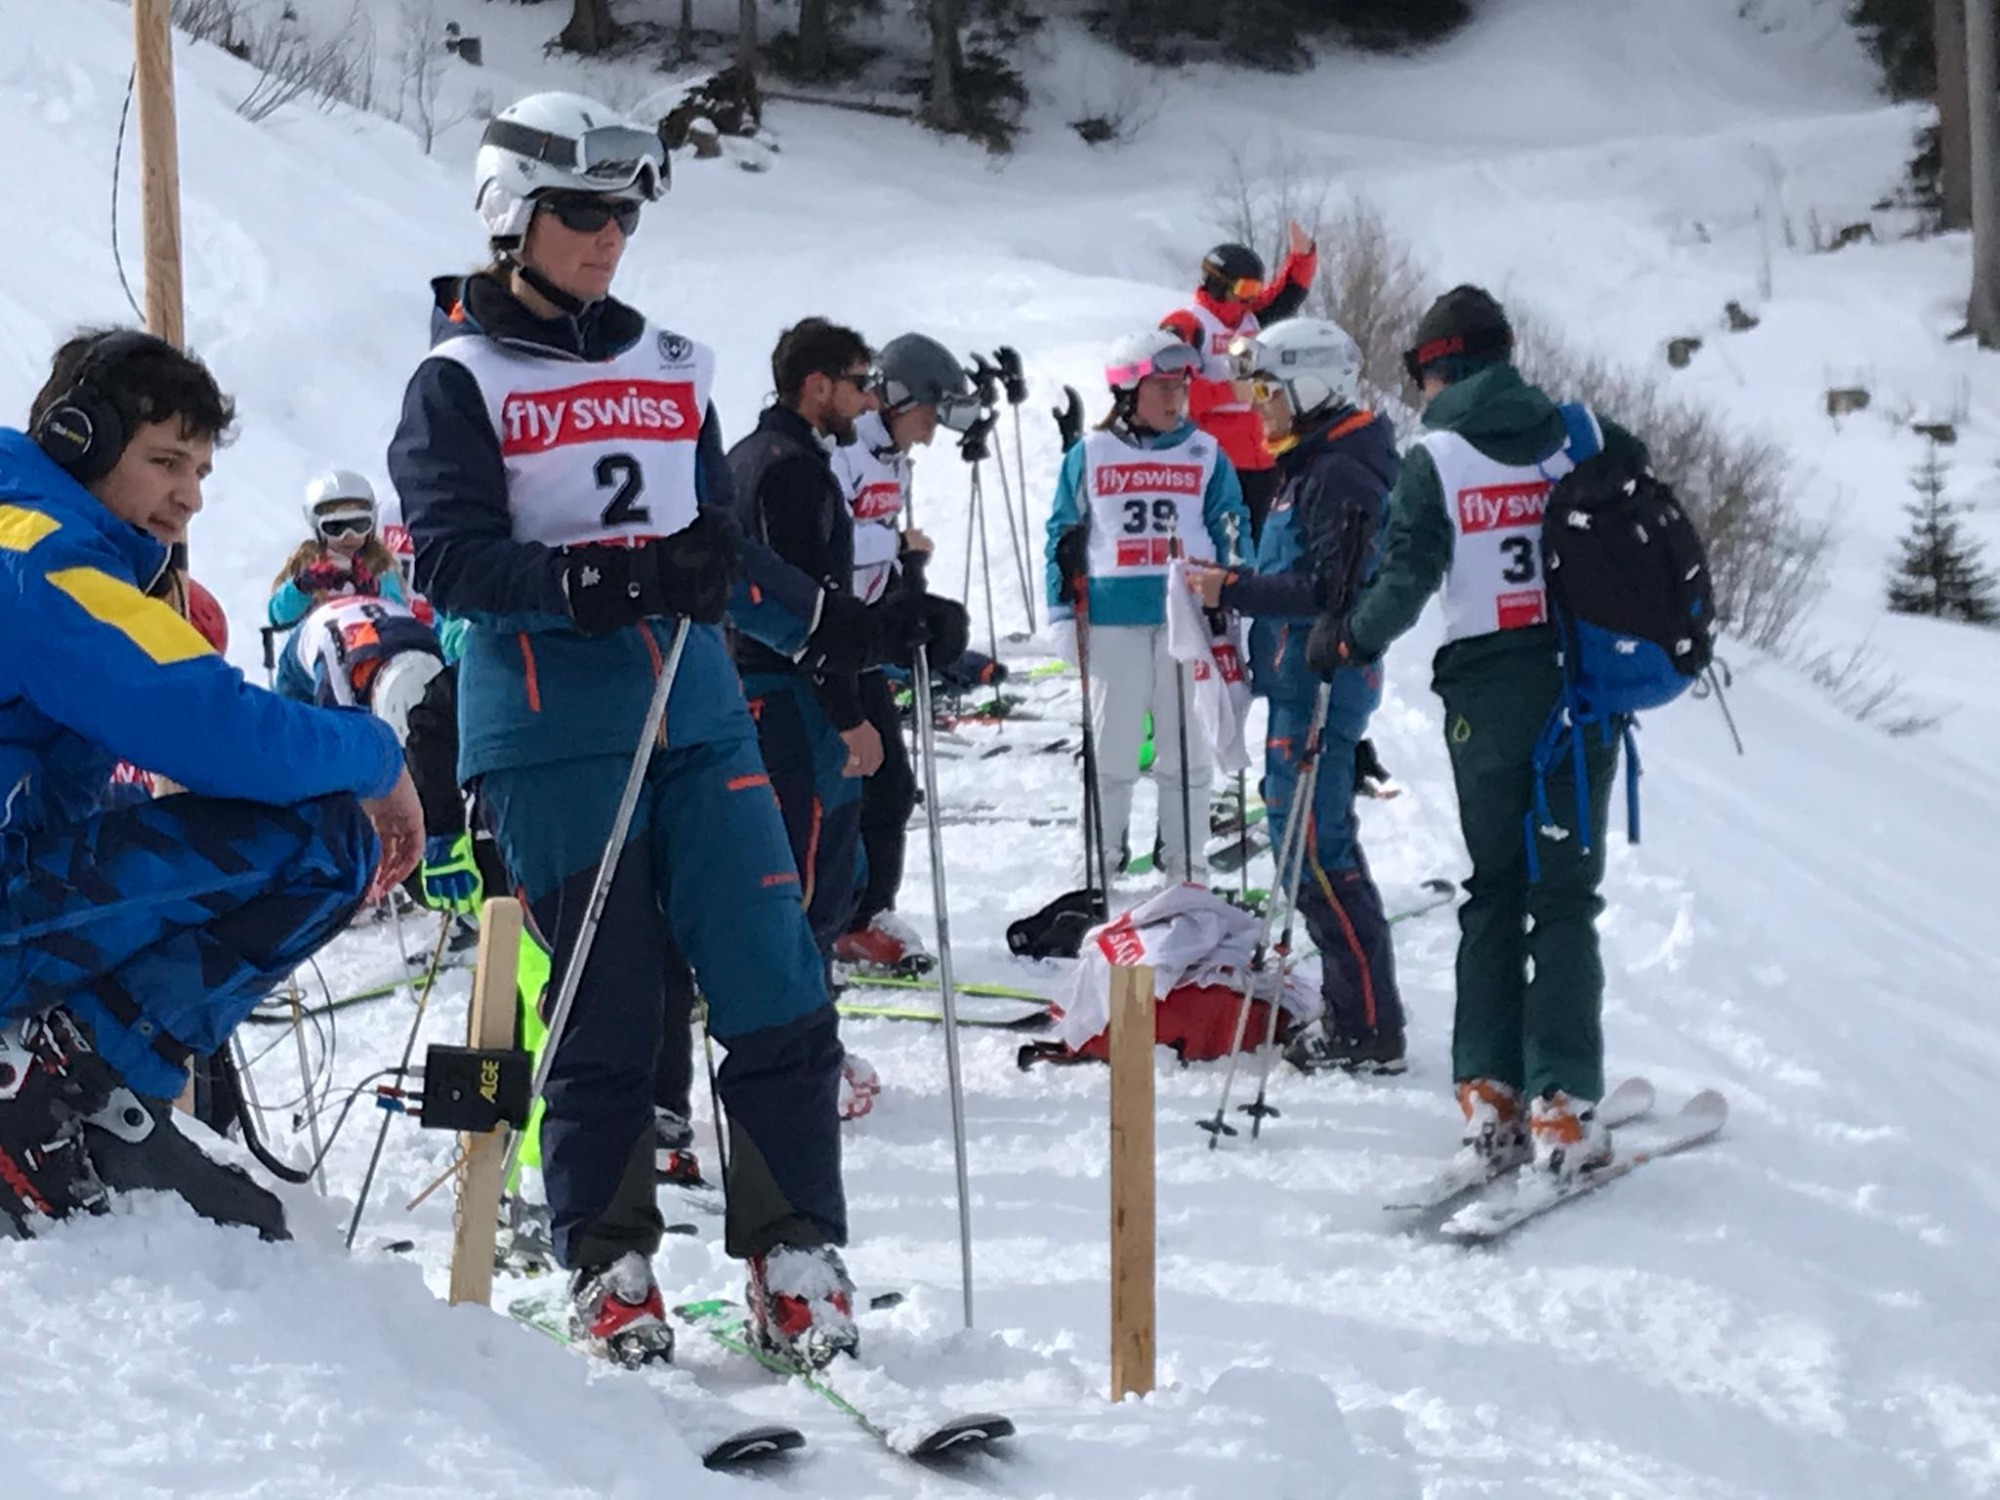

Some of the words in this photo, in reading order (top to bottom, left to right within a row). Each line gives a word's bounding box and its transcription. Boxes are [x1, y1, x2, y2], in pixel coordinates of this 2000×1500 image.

[507, 400, 566, 446] fly
[572, 387, 685, 430] swiss
[592, 453, 651, 528] 2
[1102, 467, 1129, 492] fly
[1132, 467, 1195, 487] swiss
[1123, 499, 1178, 533] 39
[1463, 493, 1503, 528] fly
[1500, 536, 1535, 584] 3
